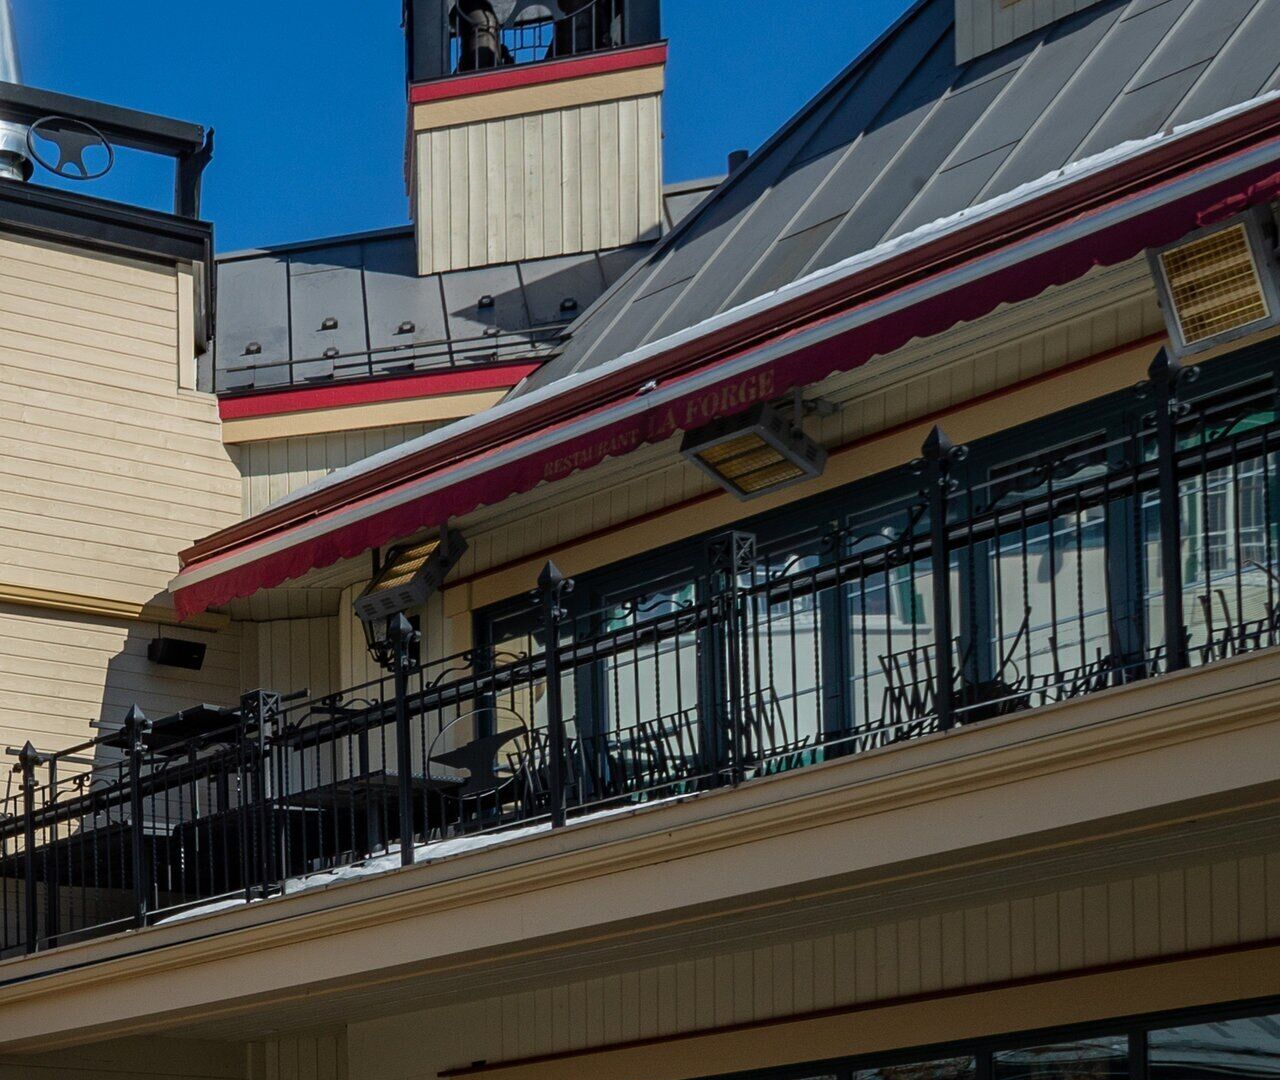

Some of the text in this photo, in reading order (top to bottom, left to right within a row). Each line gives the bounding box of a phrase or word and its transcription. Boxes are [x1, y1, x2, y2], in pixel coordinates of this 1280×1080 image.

[543, 369, 776, 478] RESTAURANT LA FORGE
